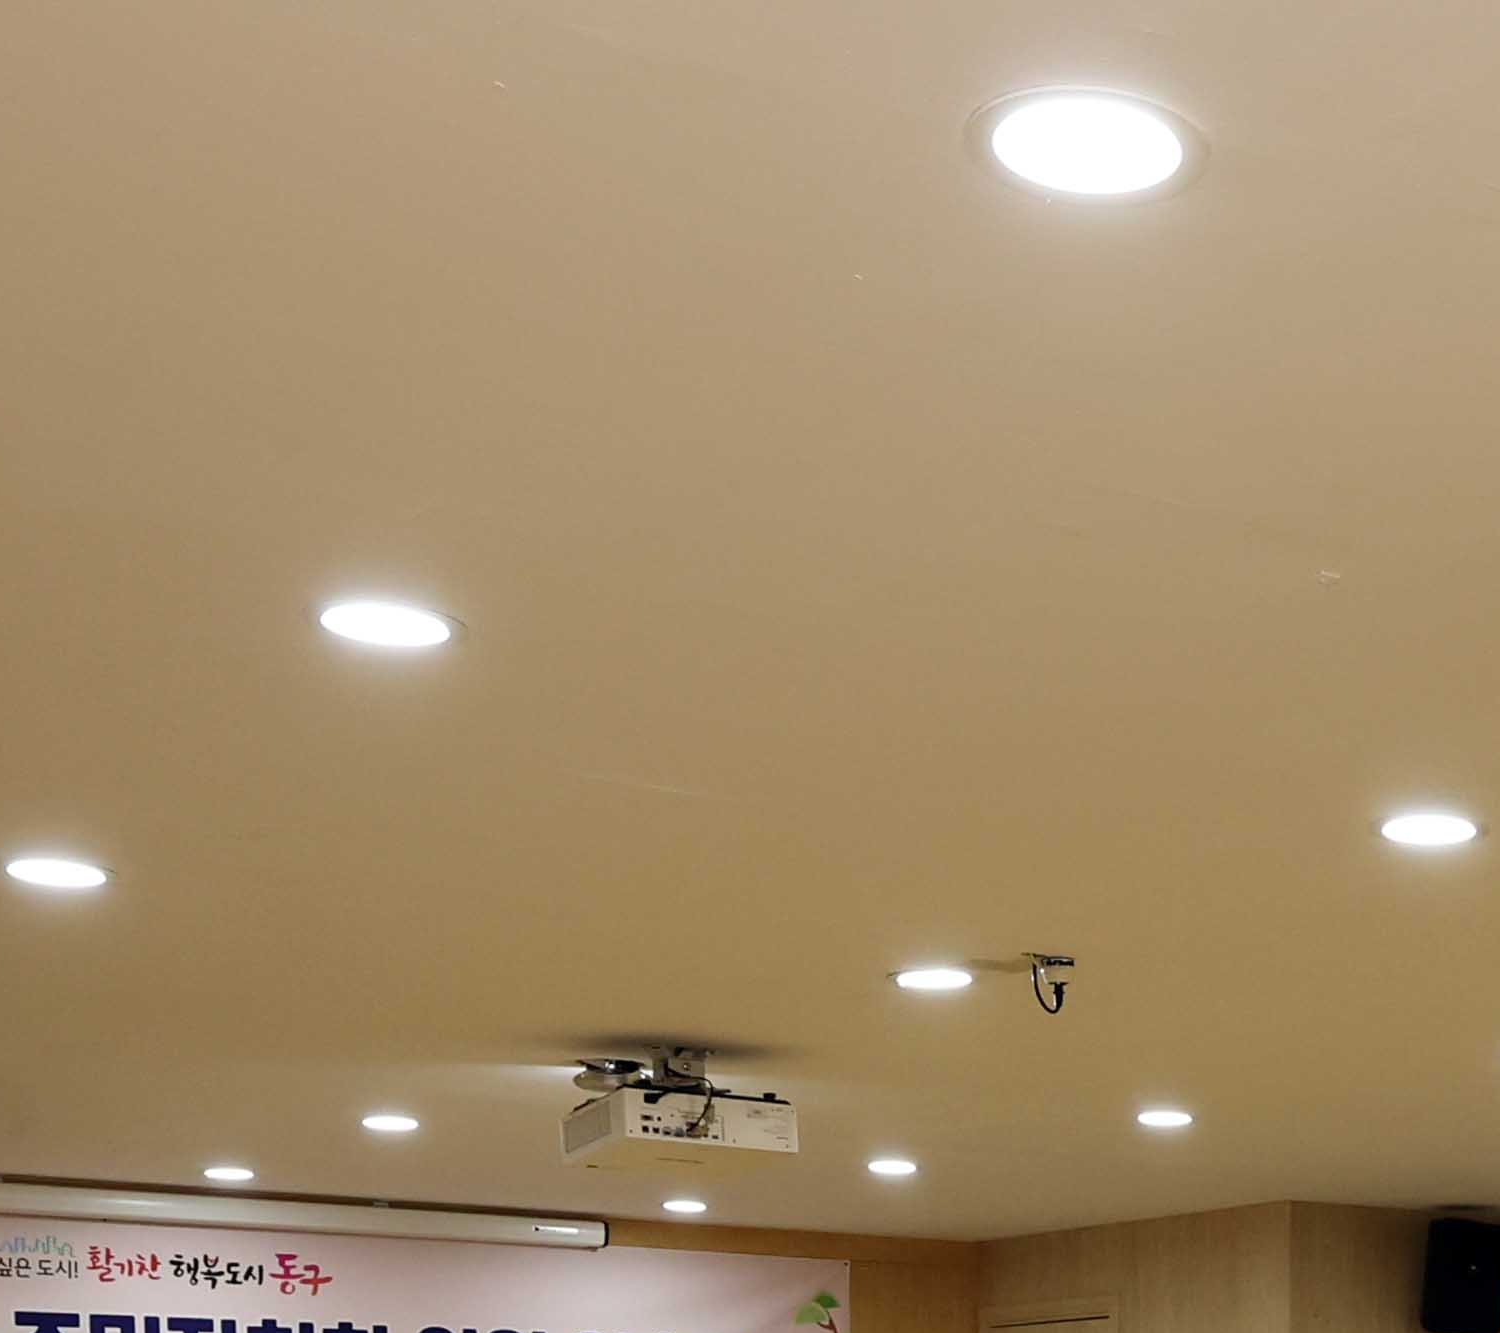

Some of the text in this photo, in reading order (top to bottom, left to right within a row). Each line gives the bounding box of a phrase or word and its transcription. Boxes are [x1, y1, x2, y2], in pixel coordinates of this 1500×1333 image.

[36, 1255, 78, 1279] 도시!
[86, 1245, 161, 1282] 활기찬
[169, 1254, 264, 1290] 행복도시
[269, 1252, 332, 1295] 동구
